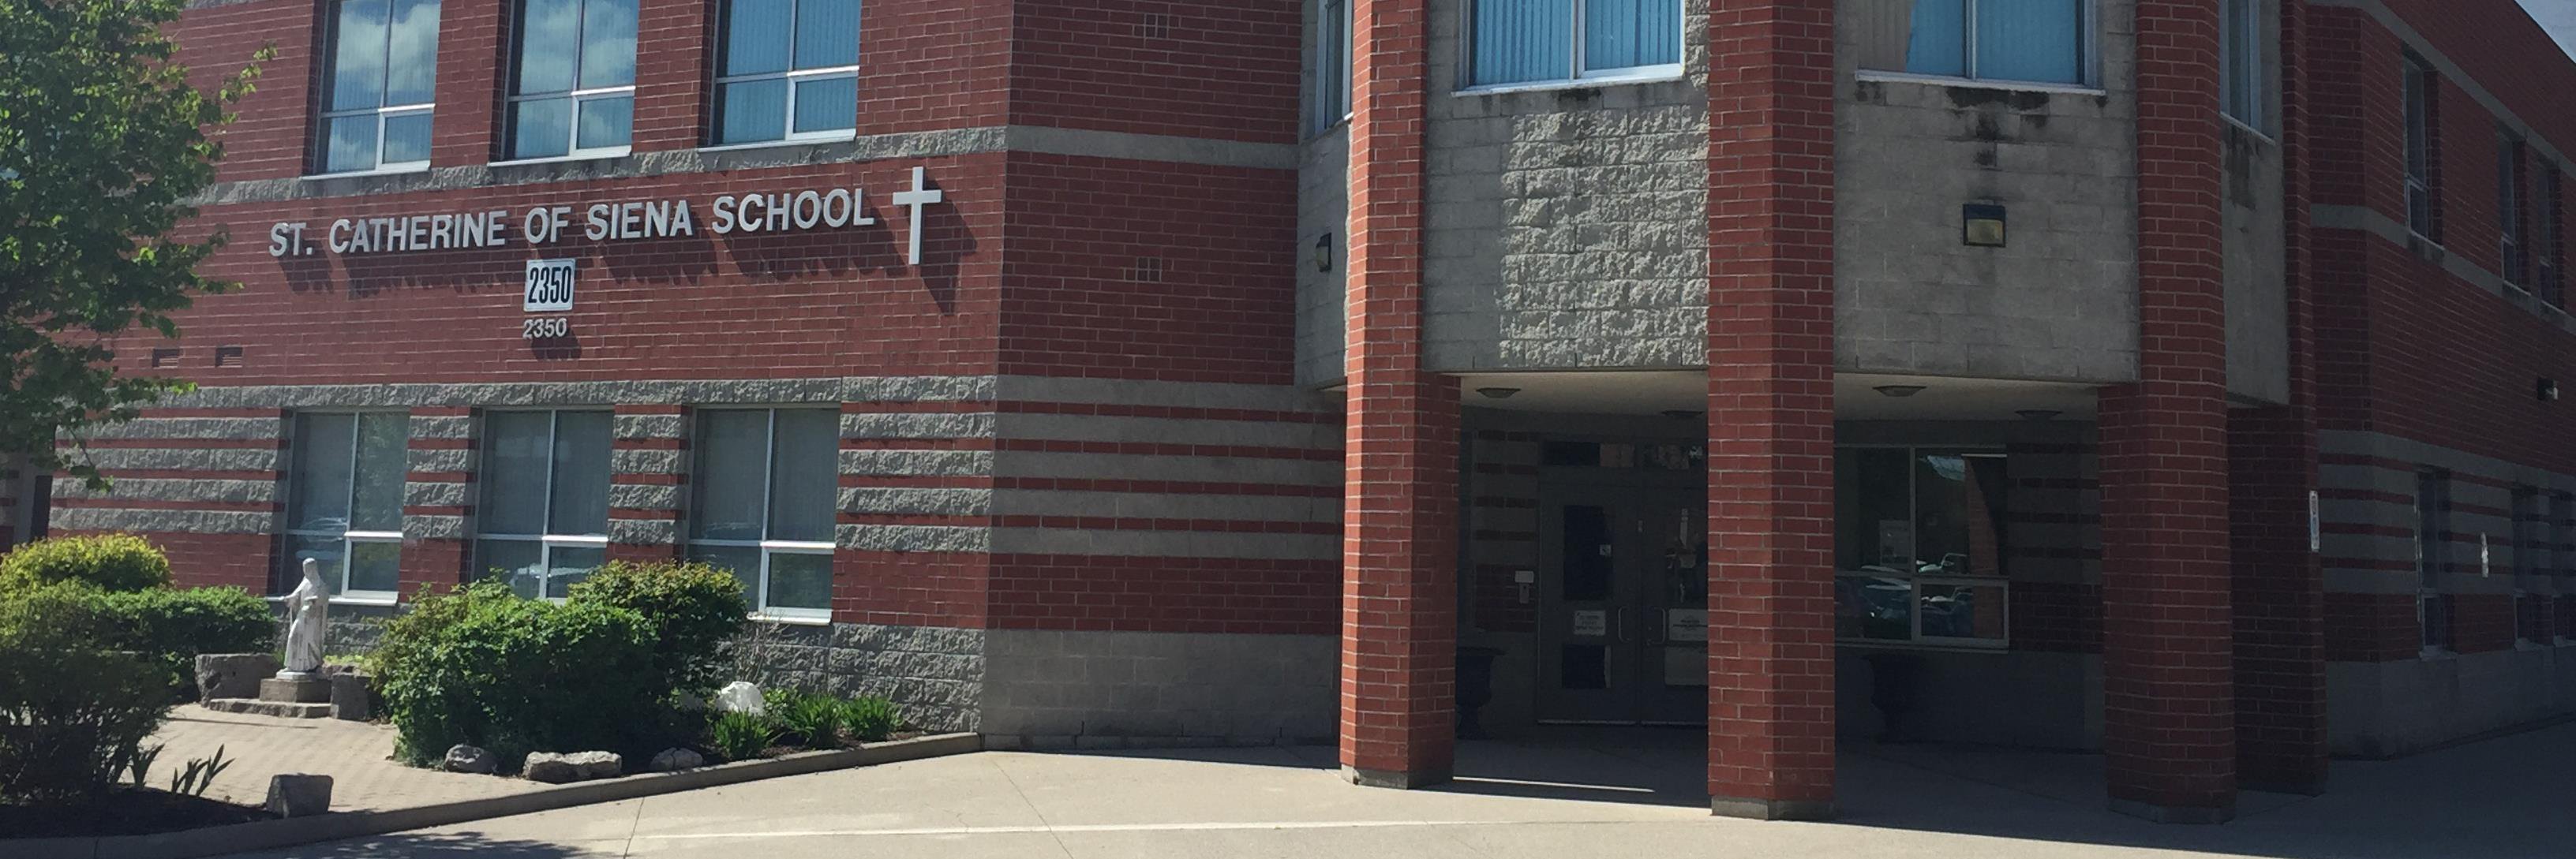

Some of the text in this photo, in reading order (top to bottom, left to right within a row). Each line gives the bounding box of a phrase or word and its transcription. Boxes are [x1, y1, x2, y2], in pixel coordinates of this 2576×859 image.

[268, 188, 874, 256] ST. CATHERINE OF SIENA SCHOOL
[528, 267, 572, 304] 2350
[522, 318, 567, 339] 2350
